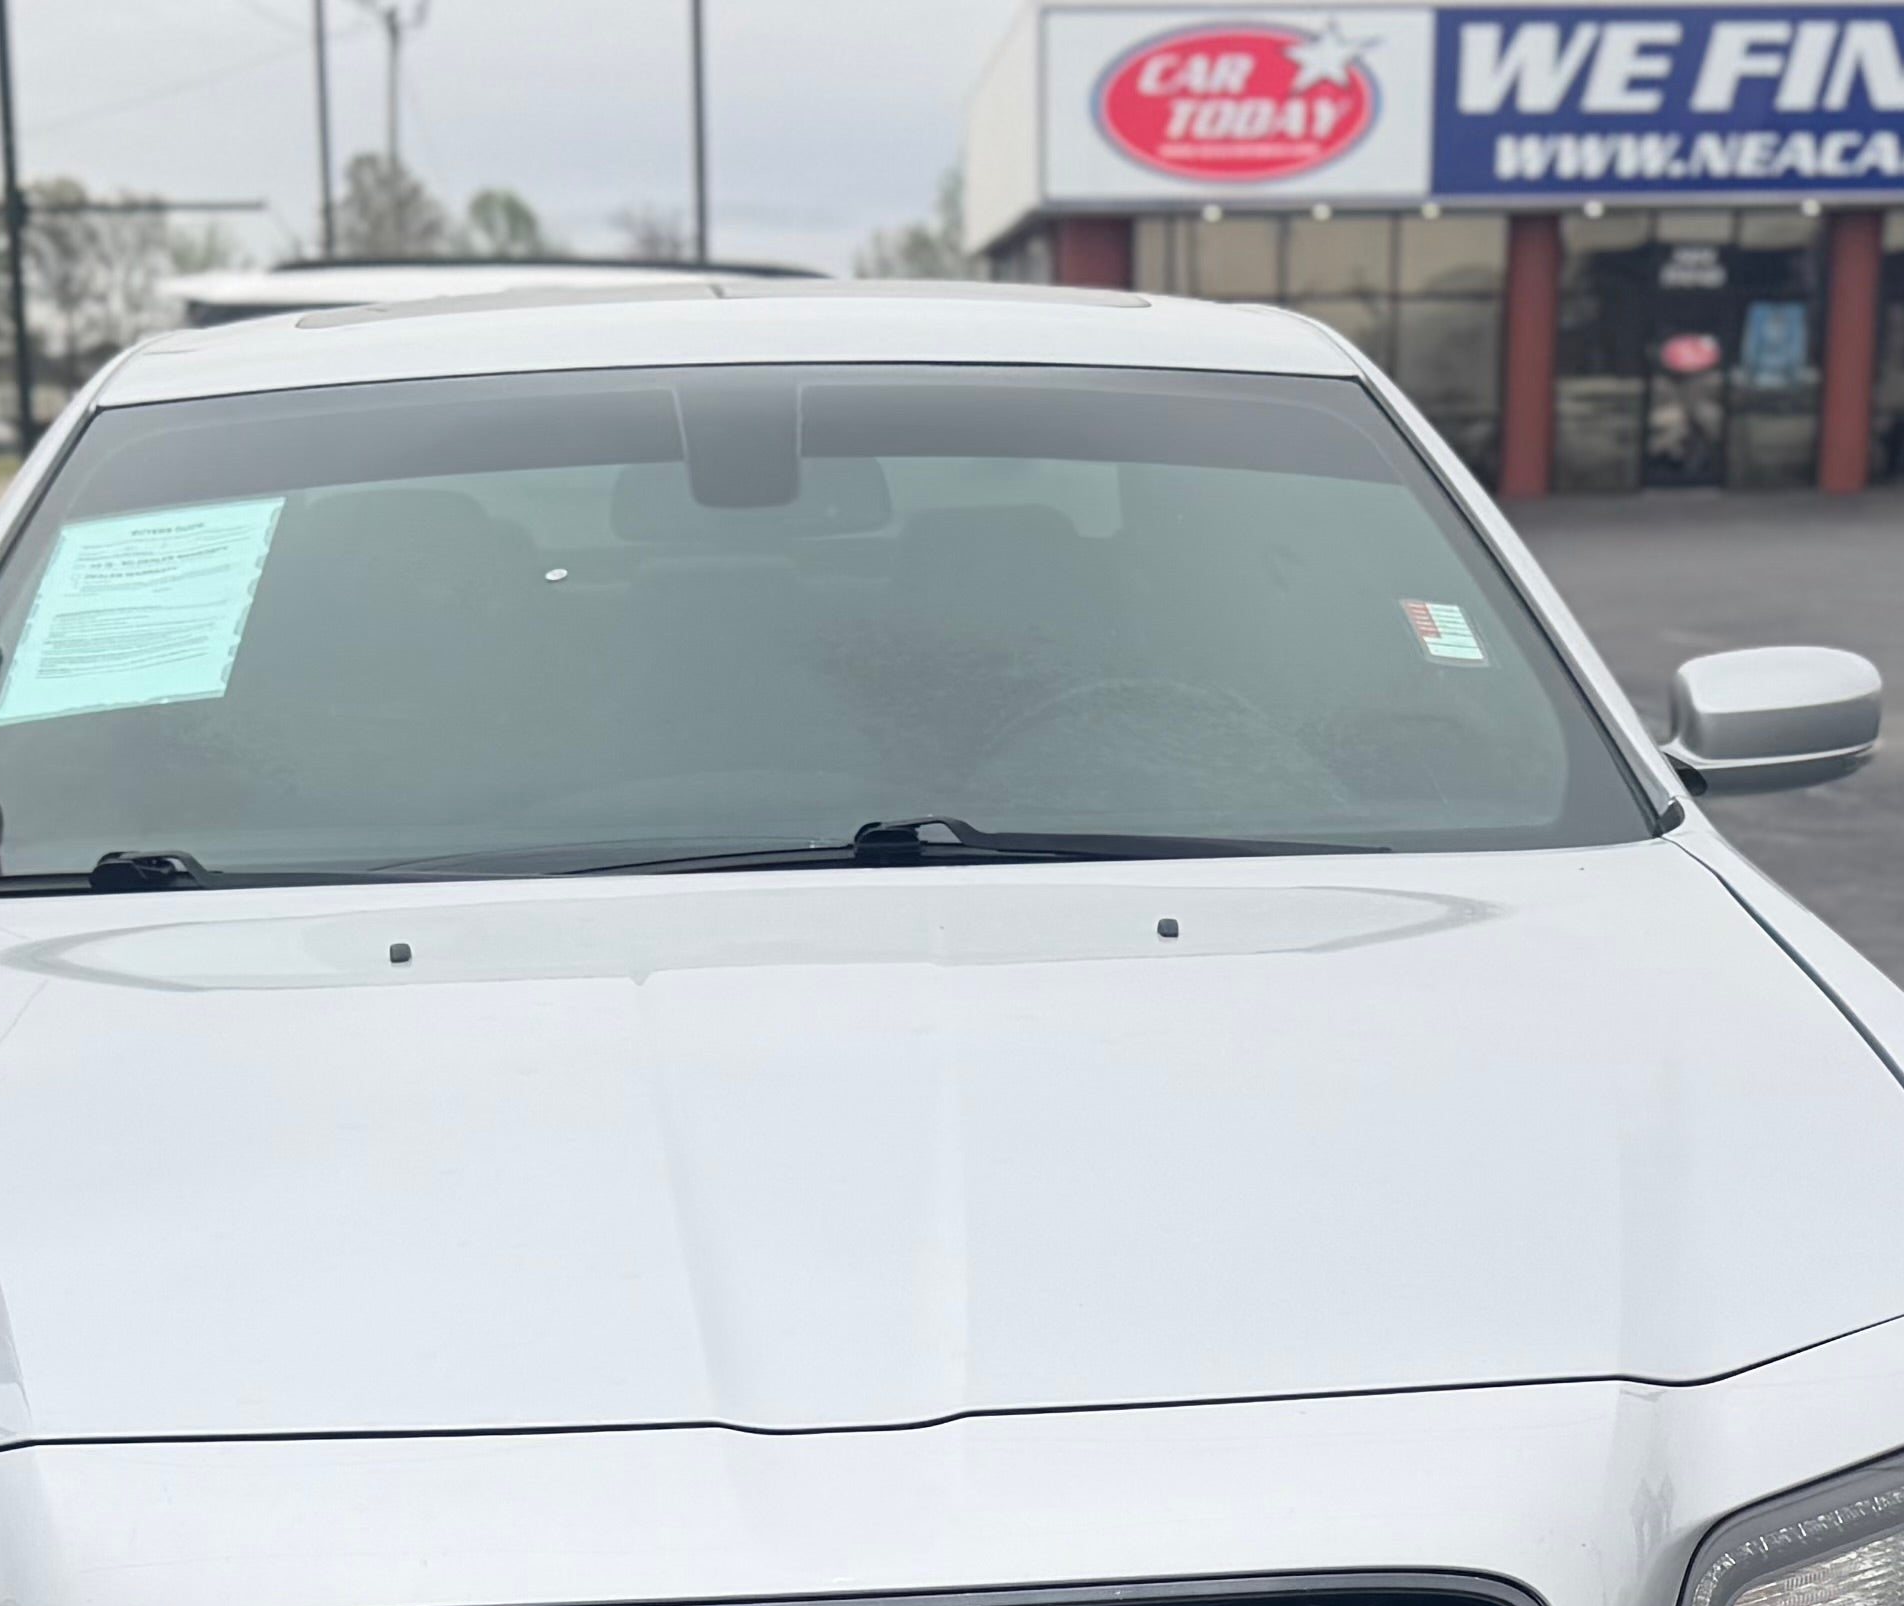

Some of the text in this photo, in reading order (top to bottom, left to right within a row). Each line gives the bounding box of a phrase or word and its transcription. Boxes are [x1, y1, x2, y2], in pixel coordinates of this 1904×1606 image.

[1136, 52, 1255, 96] CAR
[1456, 21, 1683, 115] WE
[1165, 97, 1354, 140] TODAY
